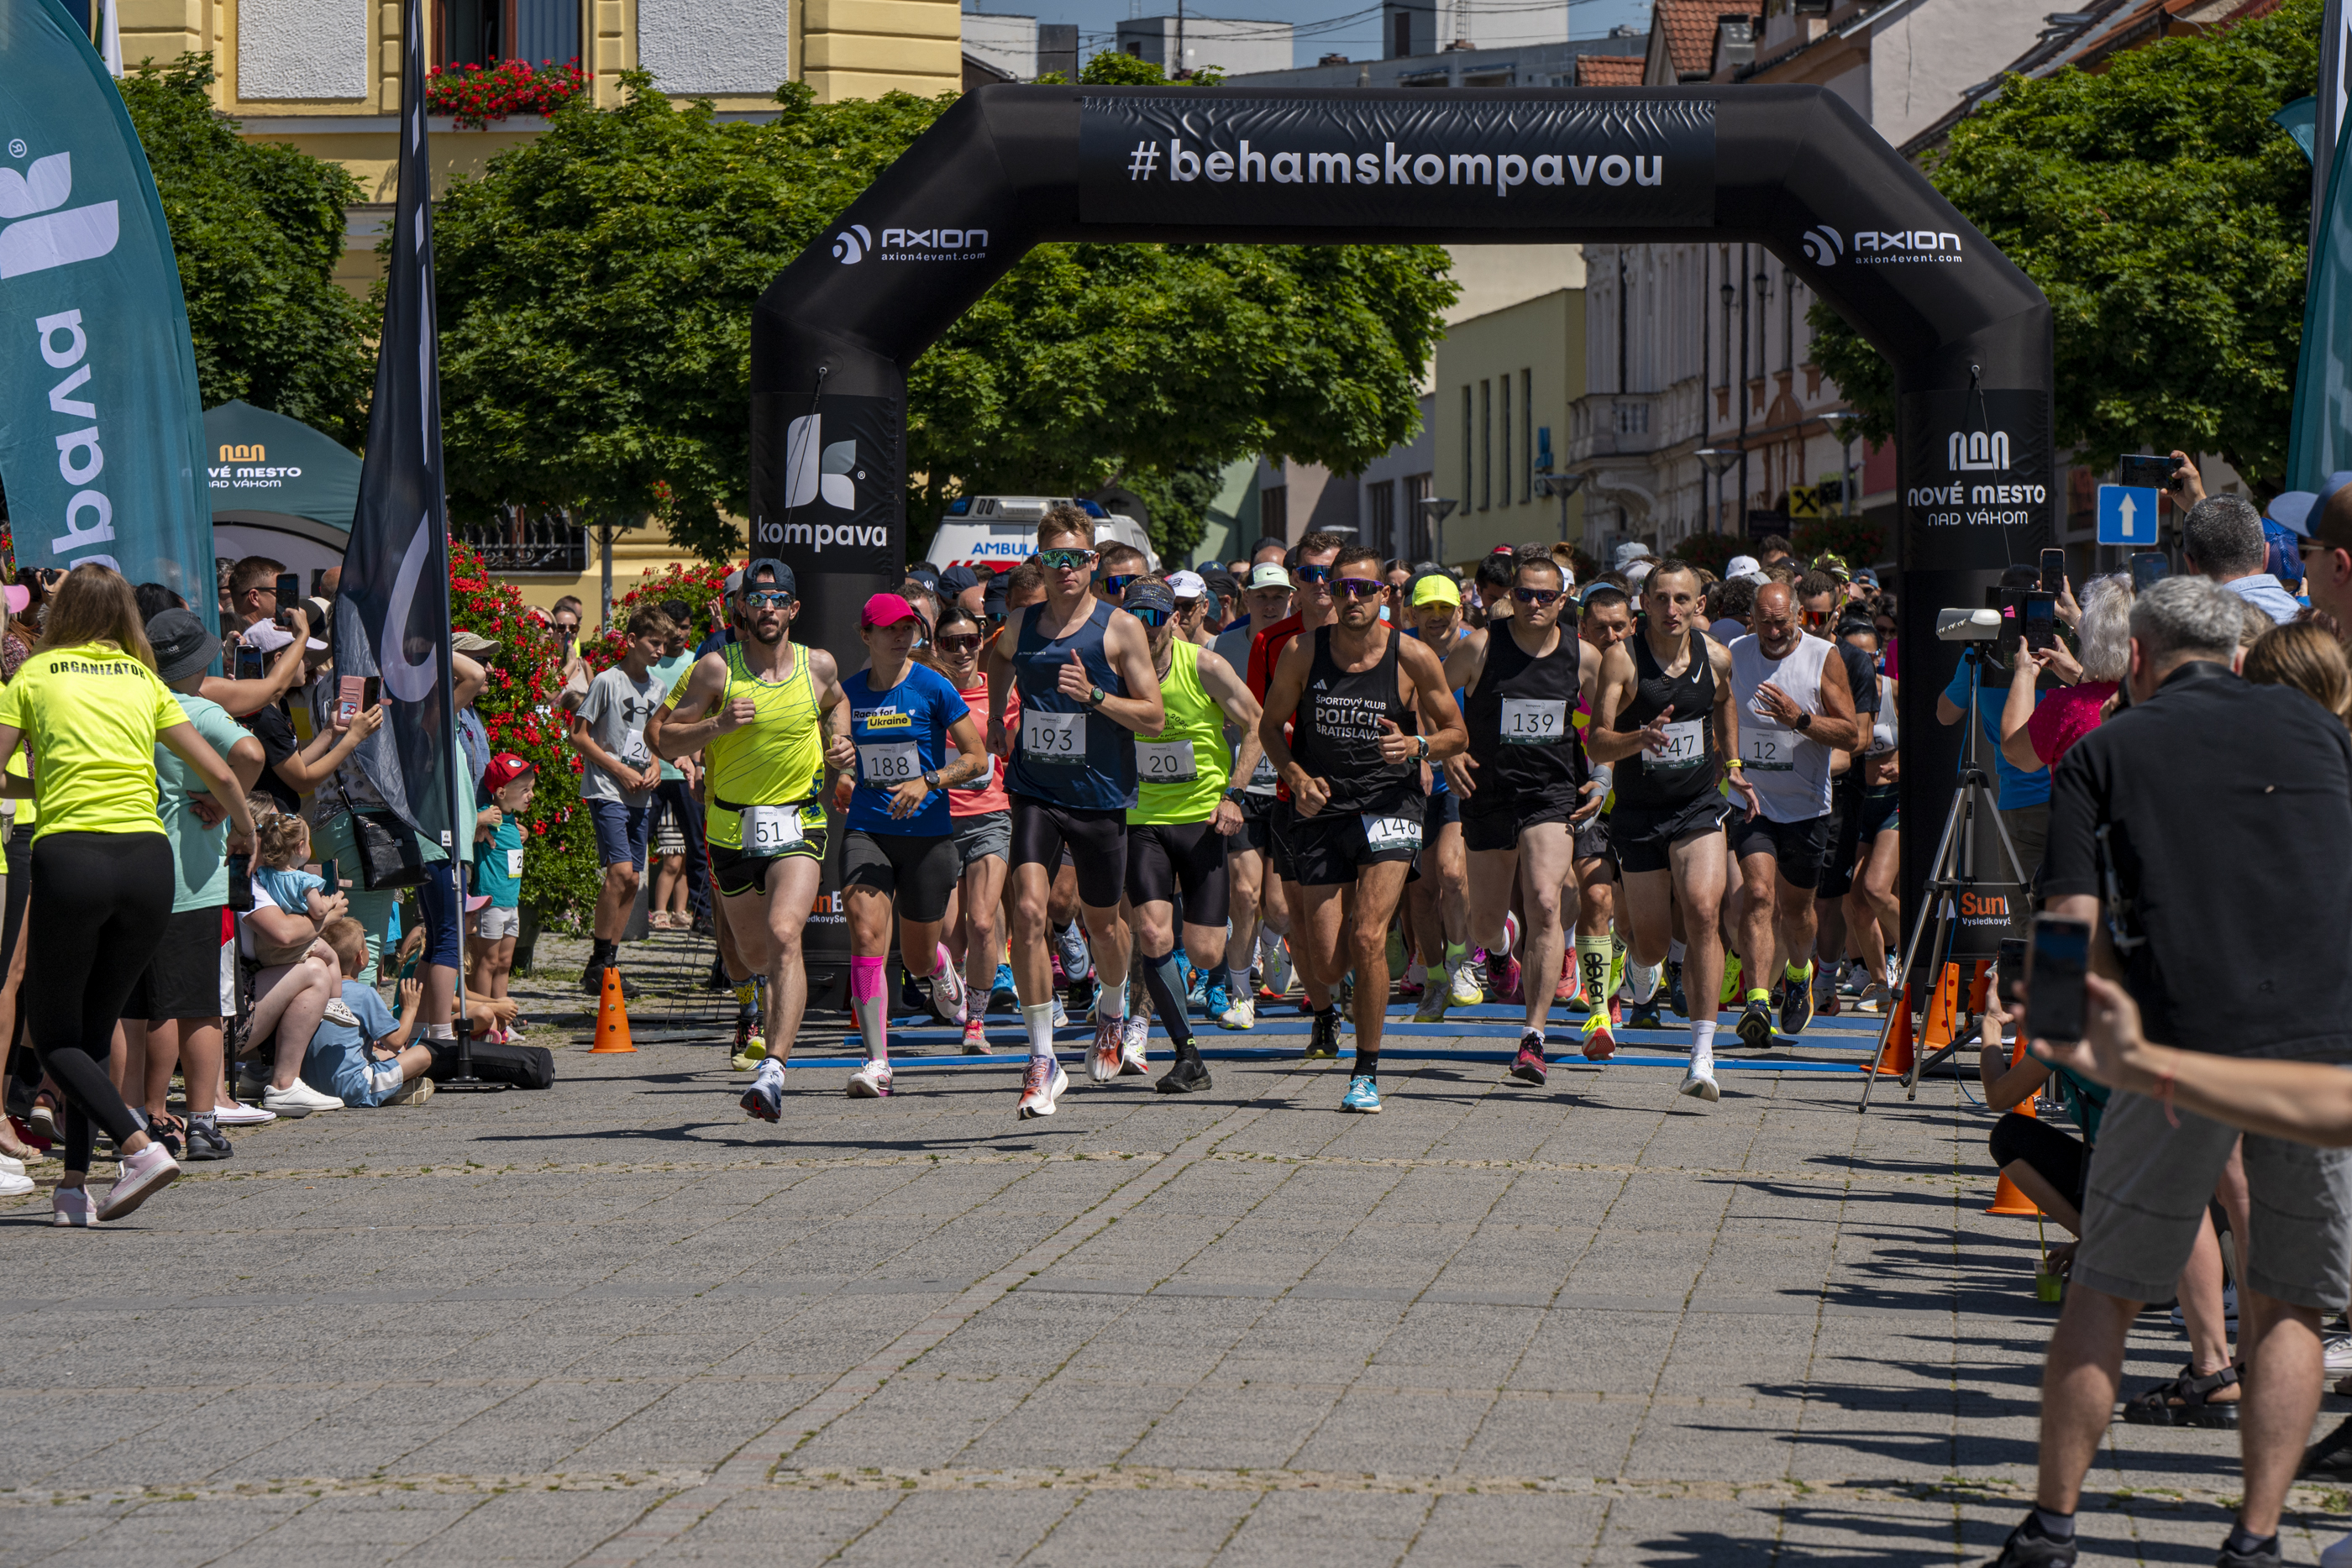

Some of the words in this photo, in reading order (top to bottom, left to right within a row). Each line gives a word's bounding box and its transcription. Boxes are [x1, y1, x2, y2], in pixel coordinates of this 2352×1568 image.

[1127, 138, 1664, 198] #behamskompavou
[882, 228, 989, 249] AXION
[1854, 230, 1962, 251] AXION
[881, 251, 986, 261] axion4event.com
[1855, 253, 1963, 265] axion4event.com
[236, 466, 302, 478] MESTO
[232, 479, 282, 489] VÁHOM
[1908, 480, 1964, 506] NOVÉ
[1971, 484, 2046, 504] MESTO
[1928, 511, 1961, 527] NAD
[1966, 507, 2029, 526] VÁHOM
[758, 515, 887, 553] kompava
[971, 542, 1039, 556] AMBULA
[50, 660, 146, 679] ORGANIZÁTOR
[1315, 694, 1362, 706] ŠPORTOVÝ
[1364, 700, 1387, 710] KLUB
[853, 711, 877, 719] Race
[879, 708, 893, 716] for
[869, 716, 908, 726] Ukraine
[1170, 713, 1189, 729] 2025
[1513, 713, 1554, 732] 139
[1031, 726, 1073, 751] 193
[1315, 722, 1380, 740] BRATISLAVA
[1753, 741, 1776, 760] 12
[871, 757, 910, 777] 188
[1149, 755, 1178, 773] 20
[756, 821, 784, 842] 51
[1377, 817, 1416, 837] 146
[1961, 892, 2009, 915] Sun
[1961, 916, 2012, 926] VysledkovyS
[1583, 952, 1611, 1006] eleven
